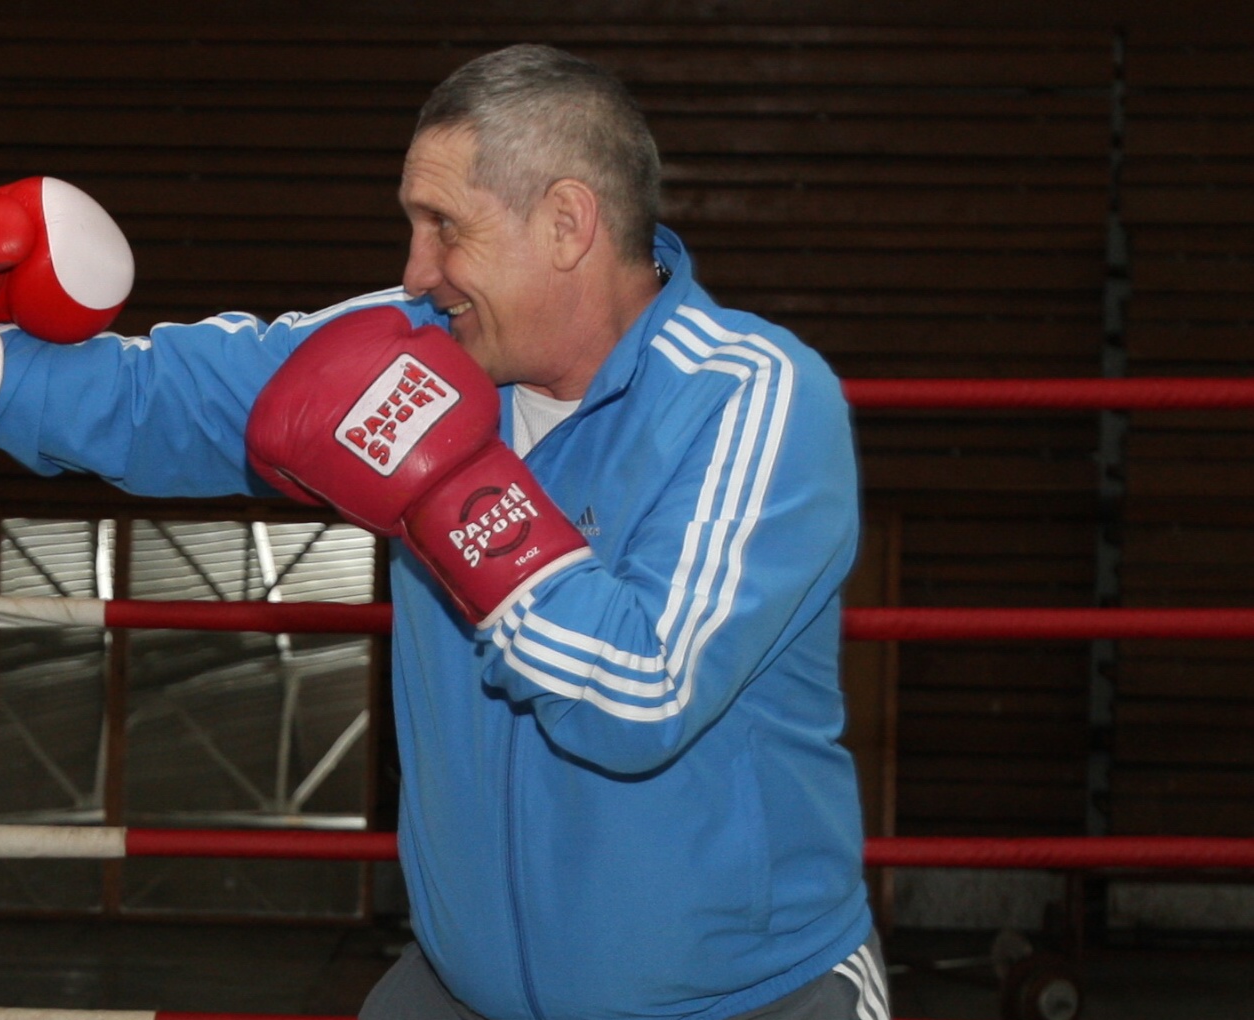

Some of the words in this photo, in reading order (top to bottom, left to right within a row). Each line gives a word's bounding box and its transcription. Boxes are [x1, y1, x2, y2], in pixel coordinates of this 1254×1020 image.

[346, 362, 428, 450] PAFFEN
[367, 378, 447, 466] SPORT
[449, 482, 526, 549] PAFFEN
[463, 500, 538, 568] SPORT
